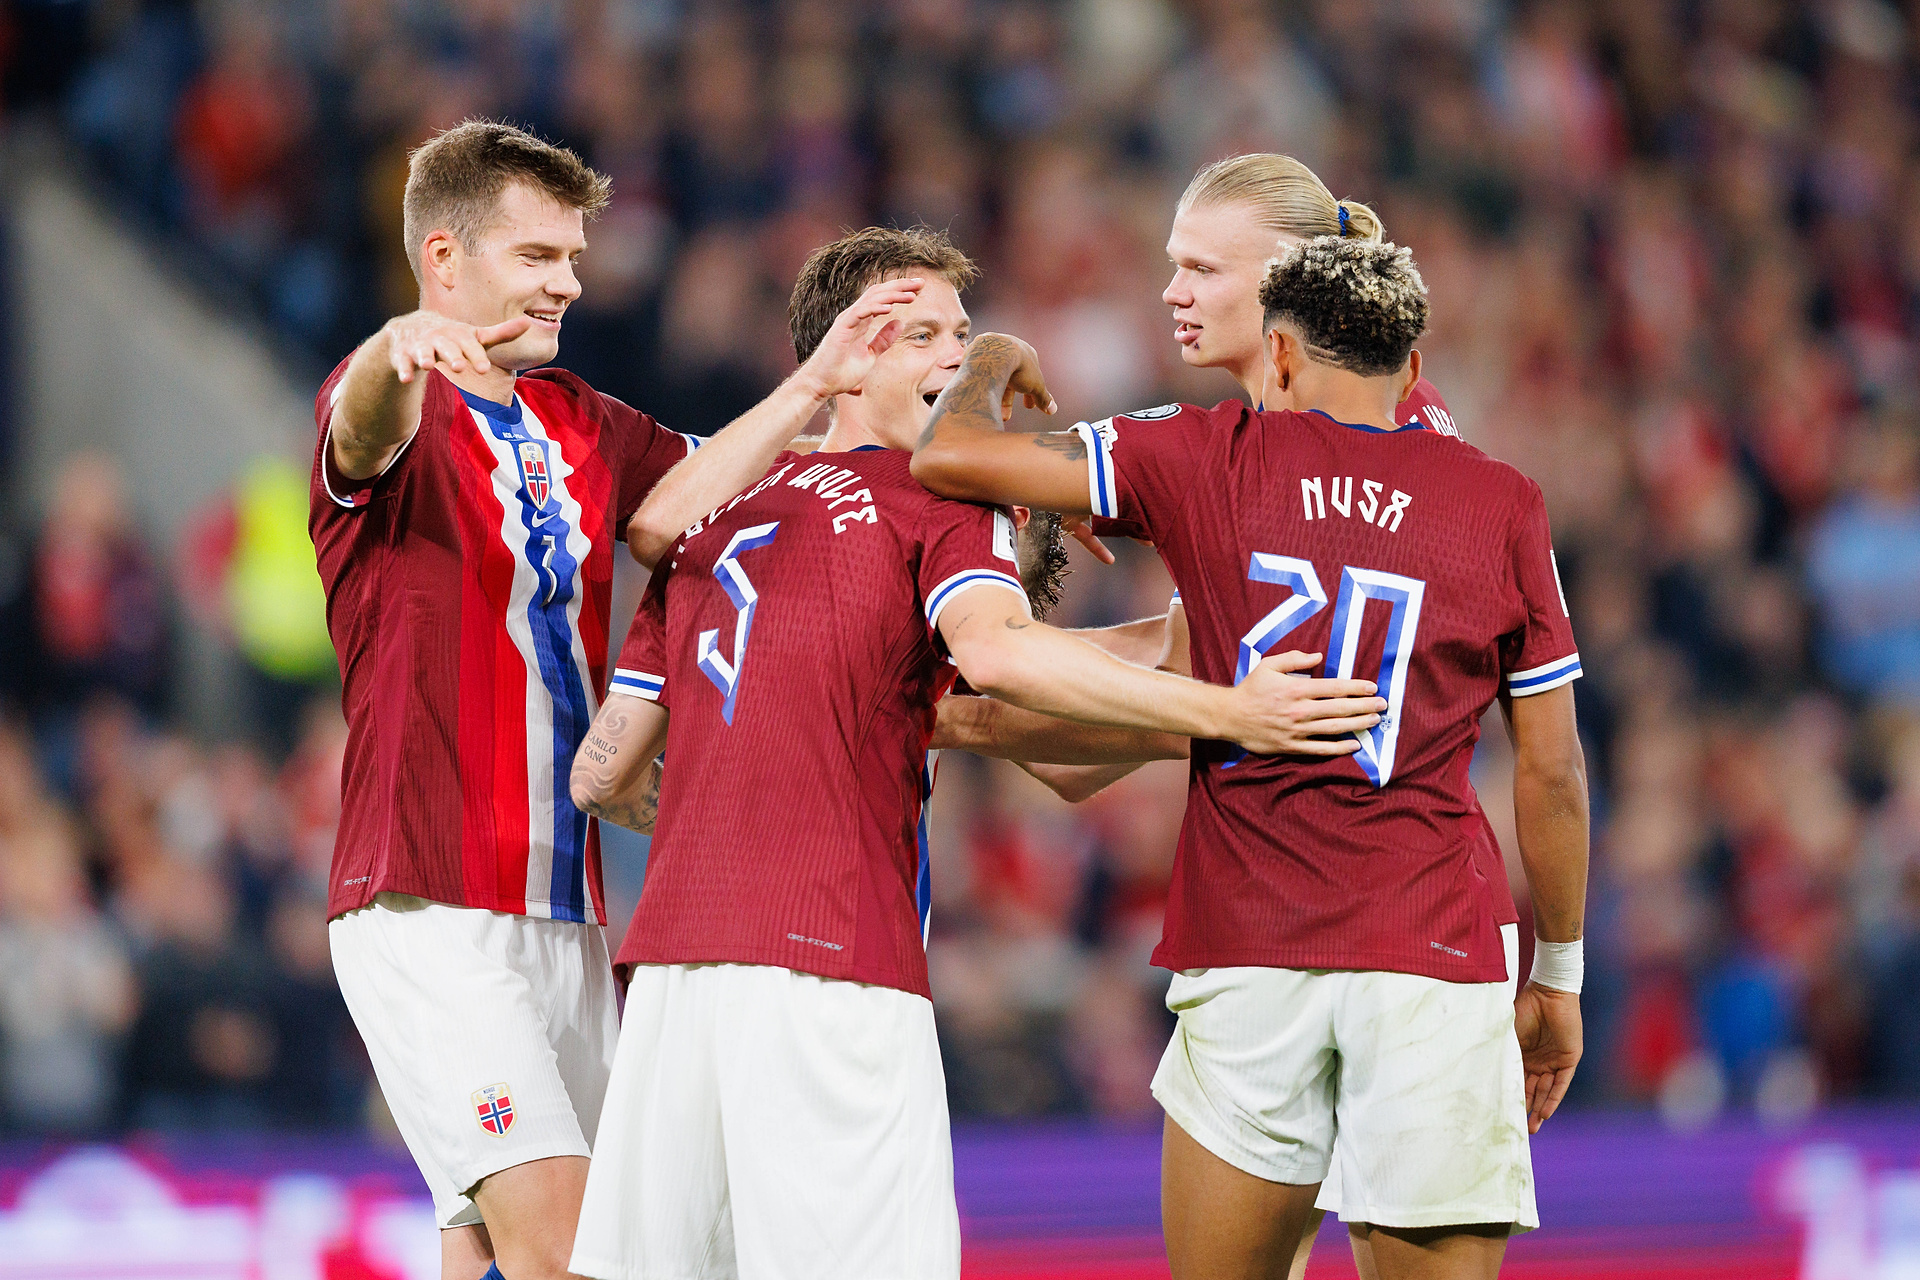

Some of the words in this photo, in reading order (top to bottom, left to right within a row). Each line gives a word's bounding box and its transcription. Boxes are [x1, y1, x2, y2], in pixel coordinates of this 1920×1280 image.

[787, 463, 878, 535] WOLFE
[1301, 476, 1413, 533] NUSA
[541, 534, 557, 608] 7
[697, 520, 781, 727] 5
[1221, 551, 1427, 788] 20
[584, 745, 607, 765] CANO
[587, 731, 618, 755] CAMILO
